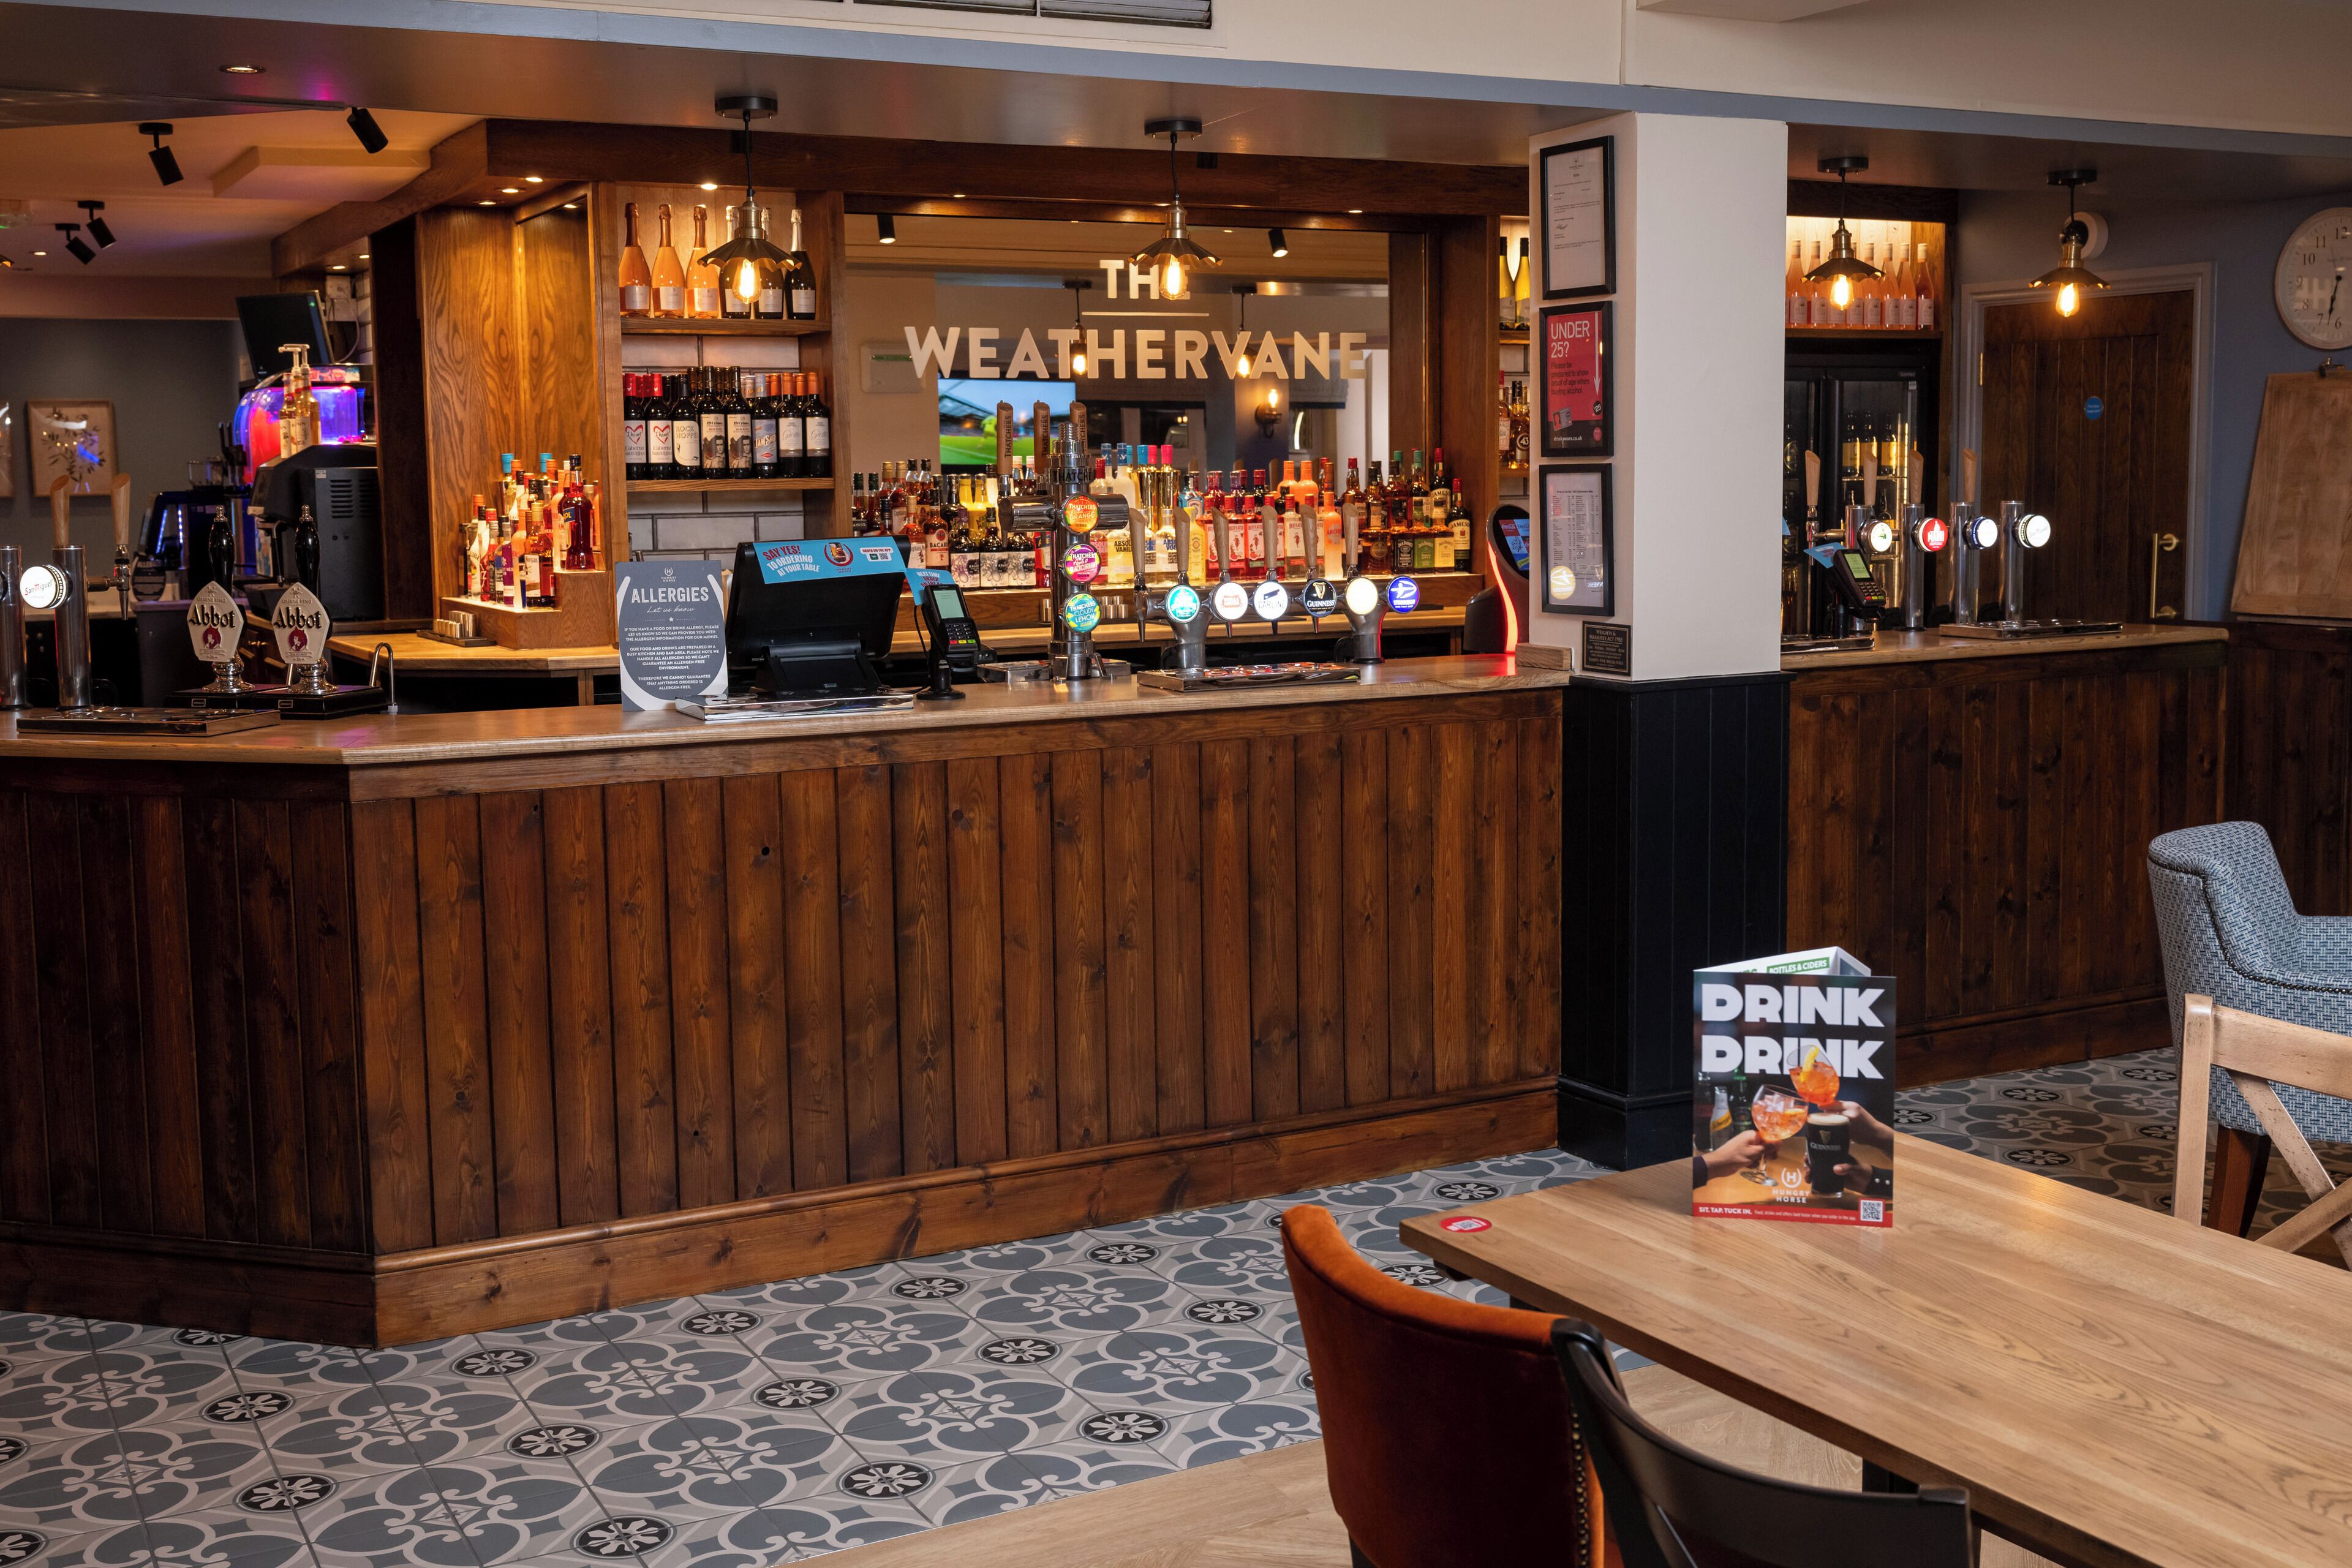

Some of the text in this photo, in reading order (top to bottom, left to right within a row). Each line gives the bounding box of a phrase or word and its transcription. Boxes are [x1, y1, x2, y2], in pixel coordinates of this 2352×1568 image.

[2335, 227, 2347, 239] 12
[2316, 236, 2326, 248] 11
[2303, 252, 2315, 266] 10
[2296, 276, 2303, 288] 9
[2302, 298, 2309, 311] 8
[2318, 314, 2323, 326] 7
[2334, 317, 2342, 330] 6
[1551, 320, 1590, 340] UNDER
[903, 326, 1367, 380] WEATHERVANE
[1551, 341, 1569, 358] 25?
[1520, 437, 1529, 445] 43
[763, 545, 801, 561] SAY YES!
[766, 554, 813, 571] TO ORDERING
[777, 564, 820, 577] AT YOUR TABLE
[631, 587, 709, 603] ALLERGIES
[1070, 600, 1096, 612] THATCHERS
[1074, 607, 1094, 617] CLOUDY
[189, 603, 236, 628] Abbot
[274, 606, 322, 629] Abbot
[1075, 613, 1095, 623] LEMON
[1769, 963, 1796, 974] BOTTLES
[1803, 960, 1827, 970] CIDERS
[1702, 983, 1885, 1027] DRINK
[1702, 1035, 1885, 1079] DRINK
[1810, 1142, 1841, 1151] GUINNESS
